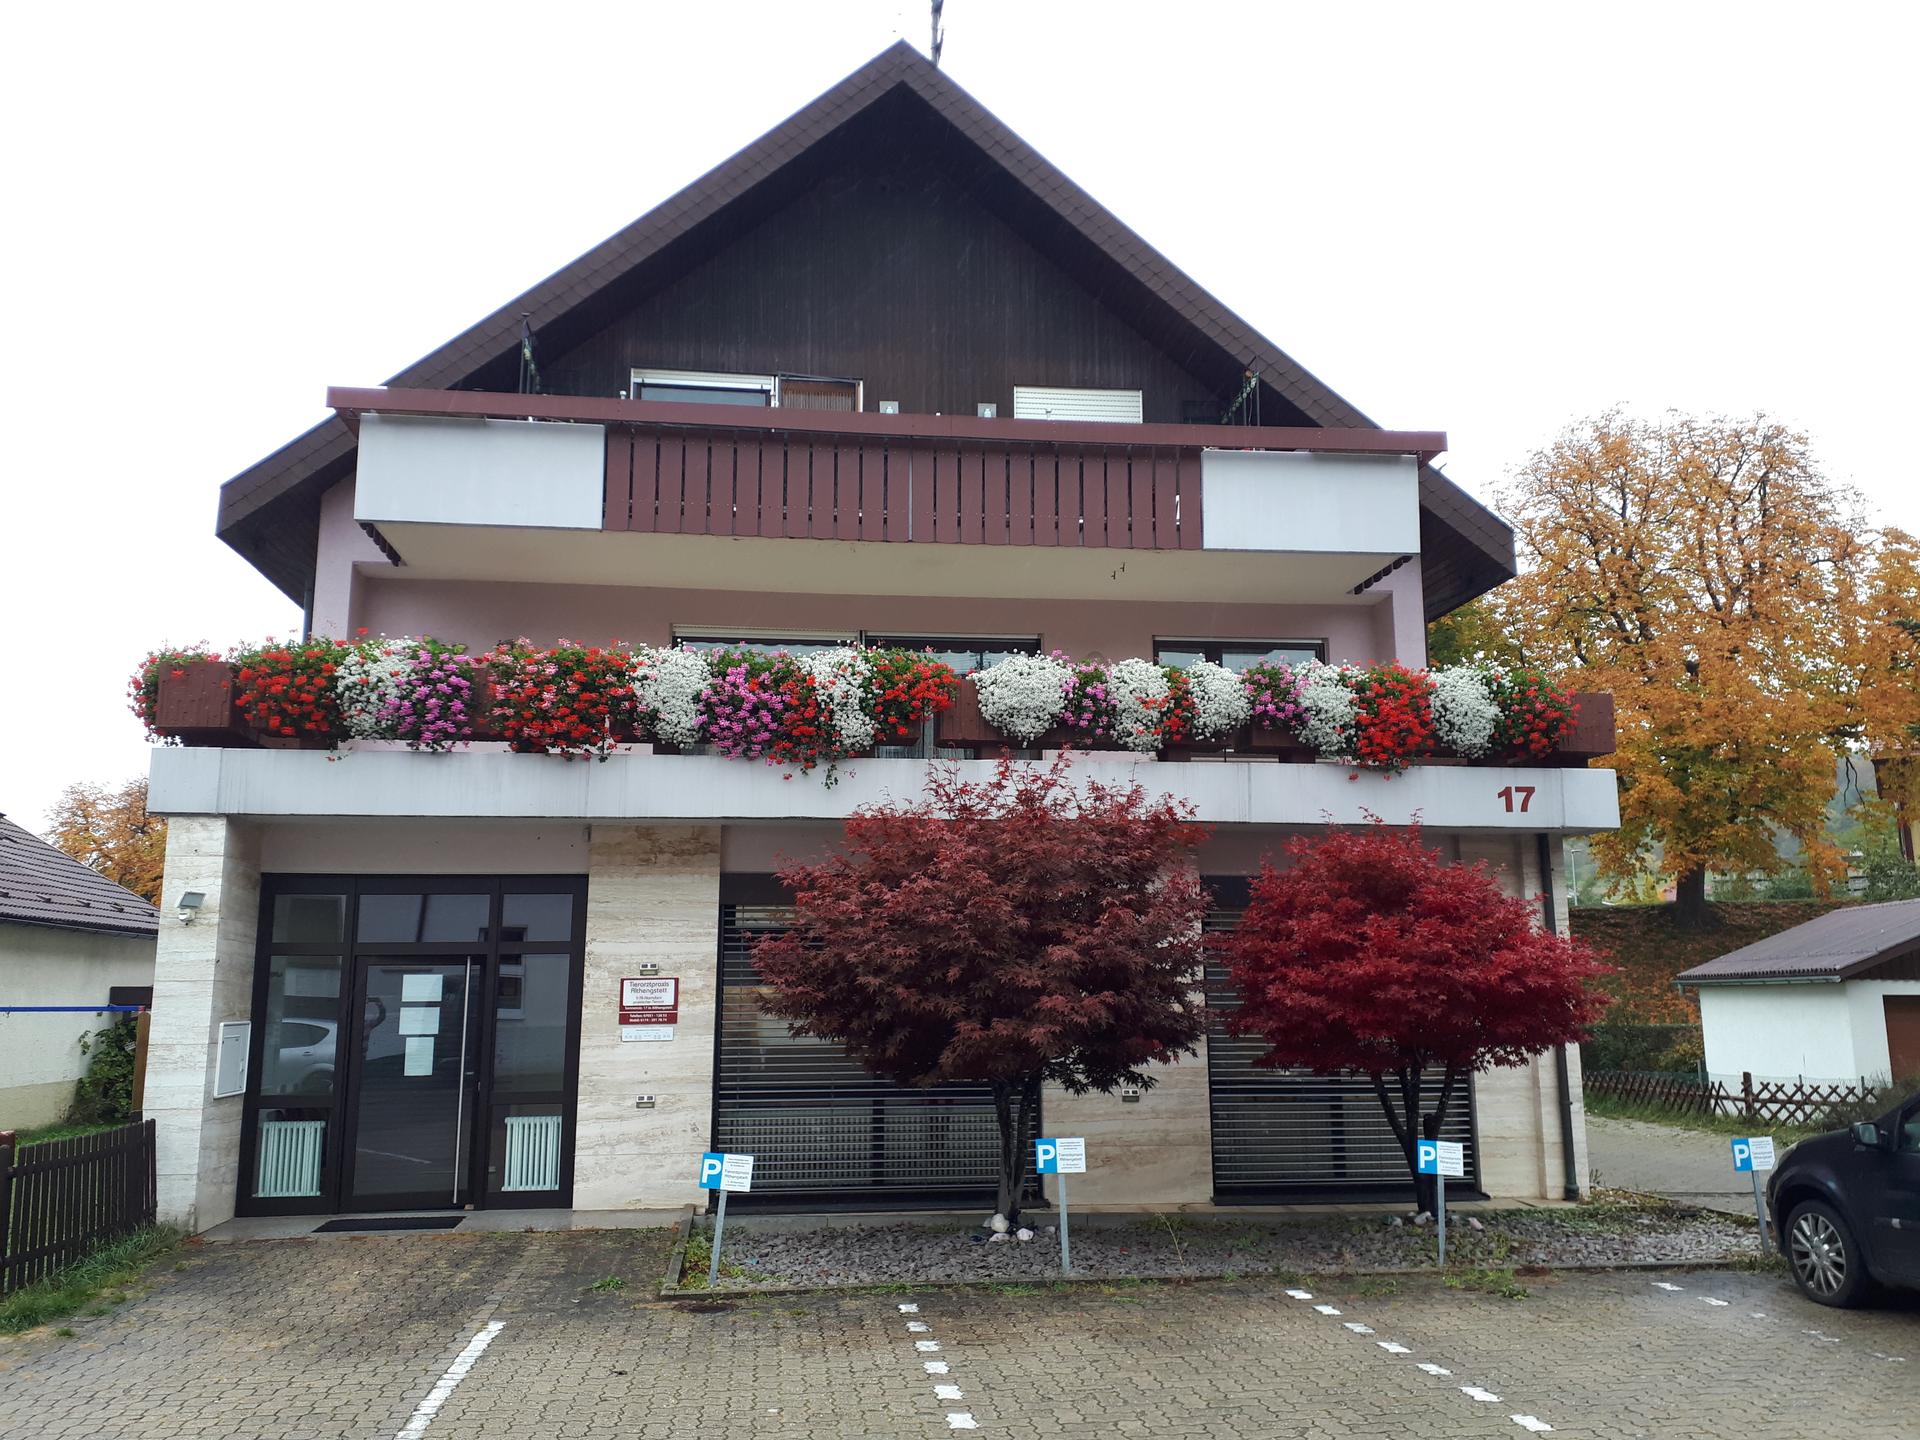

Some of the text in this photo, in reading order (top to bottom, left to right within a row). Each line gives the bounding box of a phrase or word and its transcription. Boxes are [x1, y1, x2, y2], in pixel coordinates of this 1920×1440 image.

[1497, 786, 1535, 812] 17
[1038, 1144, 1055, 1168] P
[1419, 1146, 1435, 1168] P
[1733, 1144, 1749, 1167] P
[701, 1158, 721, 1183] P
